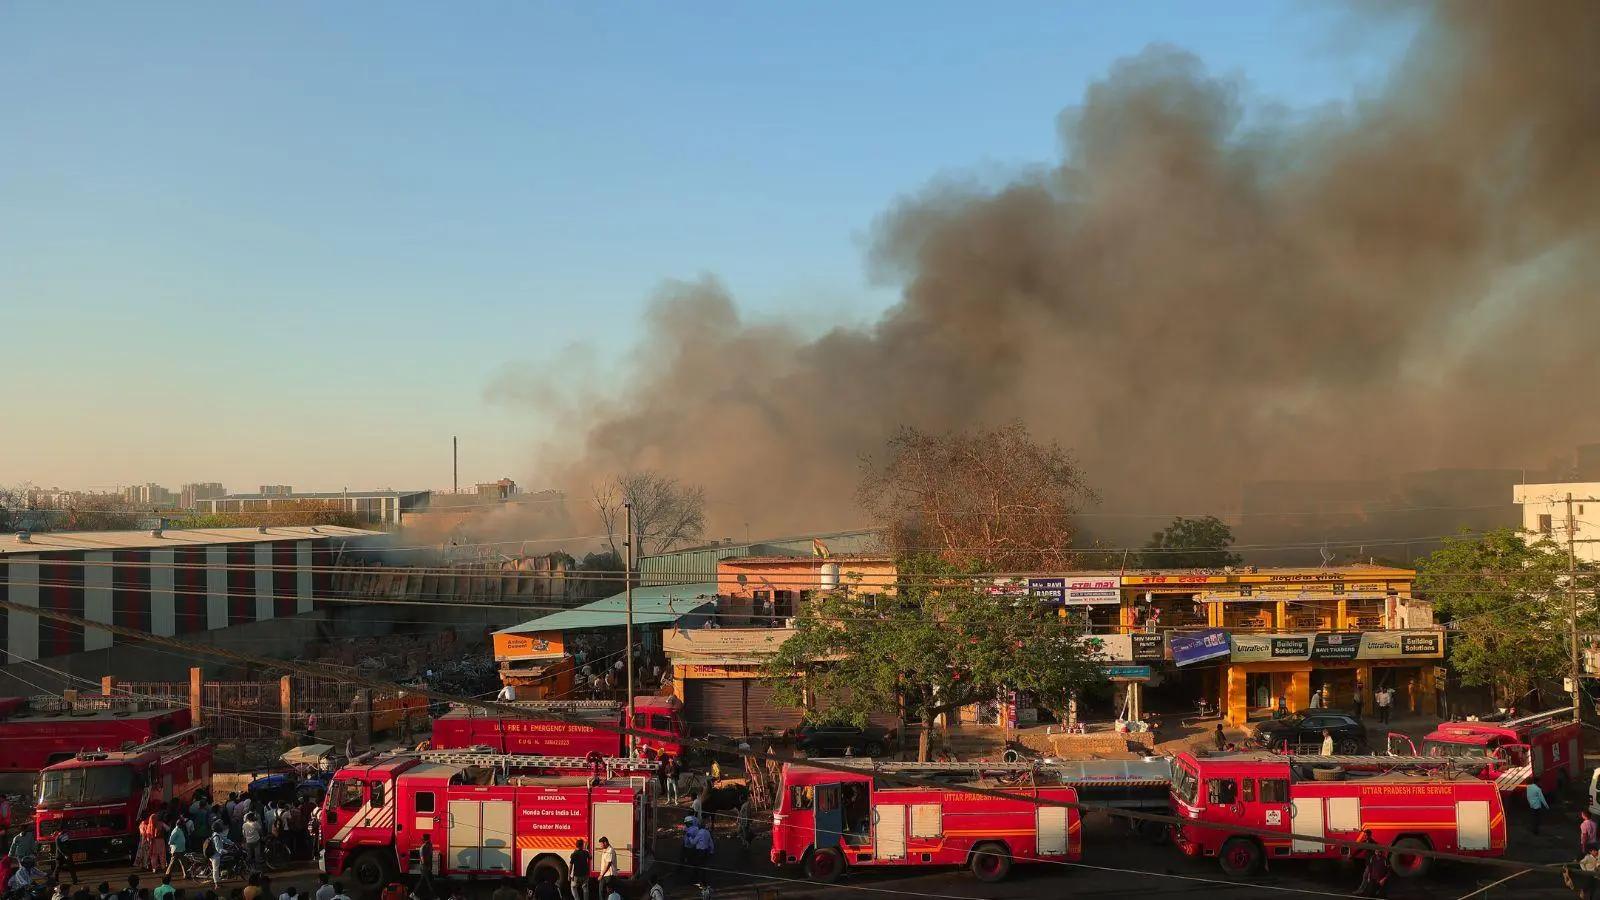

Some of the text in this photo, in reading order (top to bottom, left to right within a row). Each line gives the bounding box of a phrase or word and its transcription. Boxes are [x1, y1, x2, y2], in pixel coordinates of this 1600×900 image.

[1406, 638, 1433, 646] Building
[1237, 644, 1270, 652] UltraTech
[508, 724, 520, 732] FIRE
[530, 724, 566, 732] EMERGENCY
[568, 725, 594, 733] SERVICES
[1362, 786, 1452, 795] UTTAR PRADESH FIRE SERVICE
[944, 793, 963, 802] UTTAR
